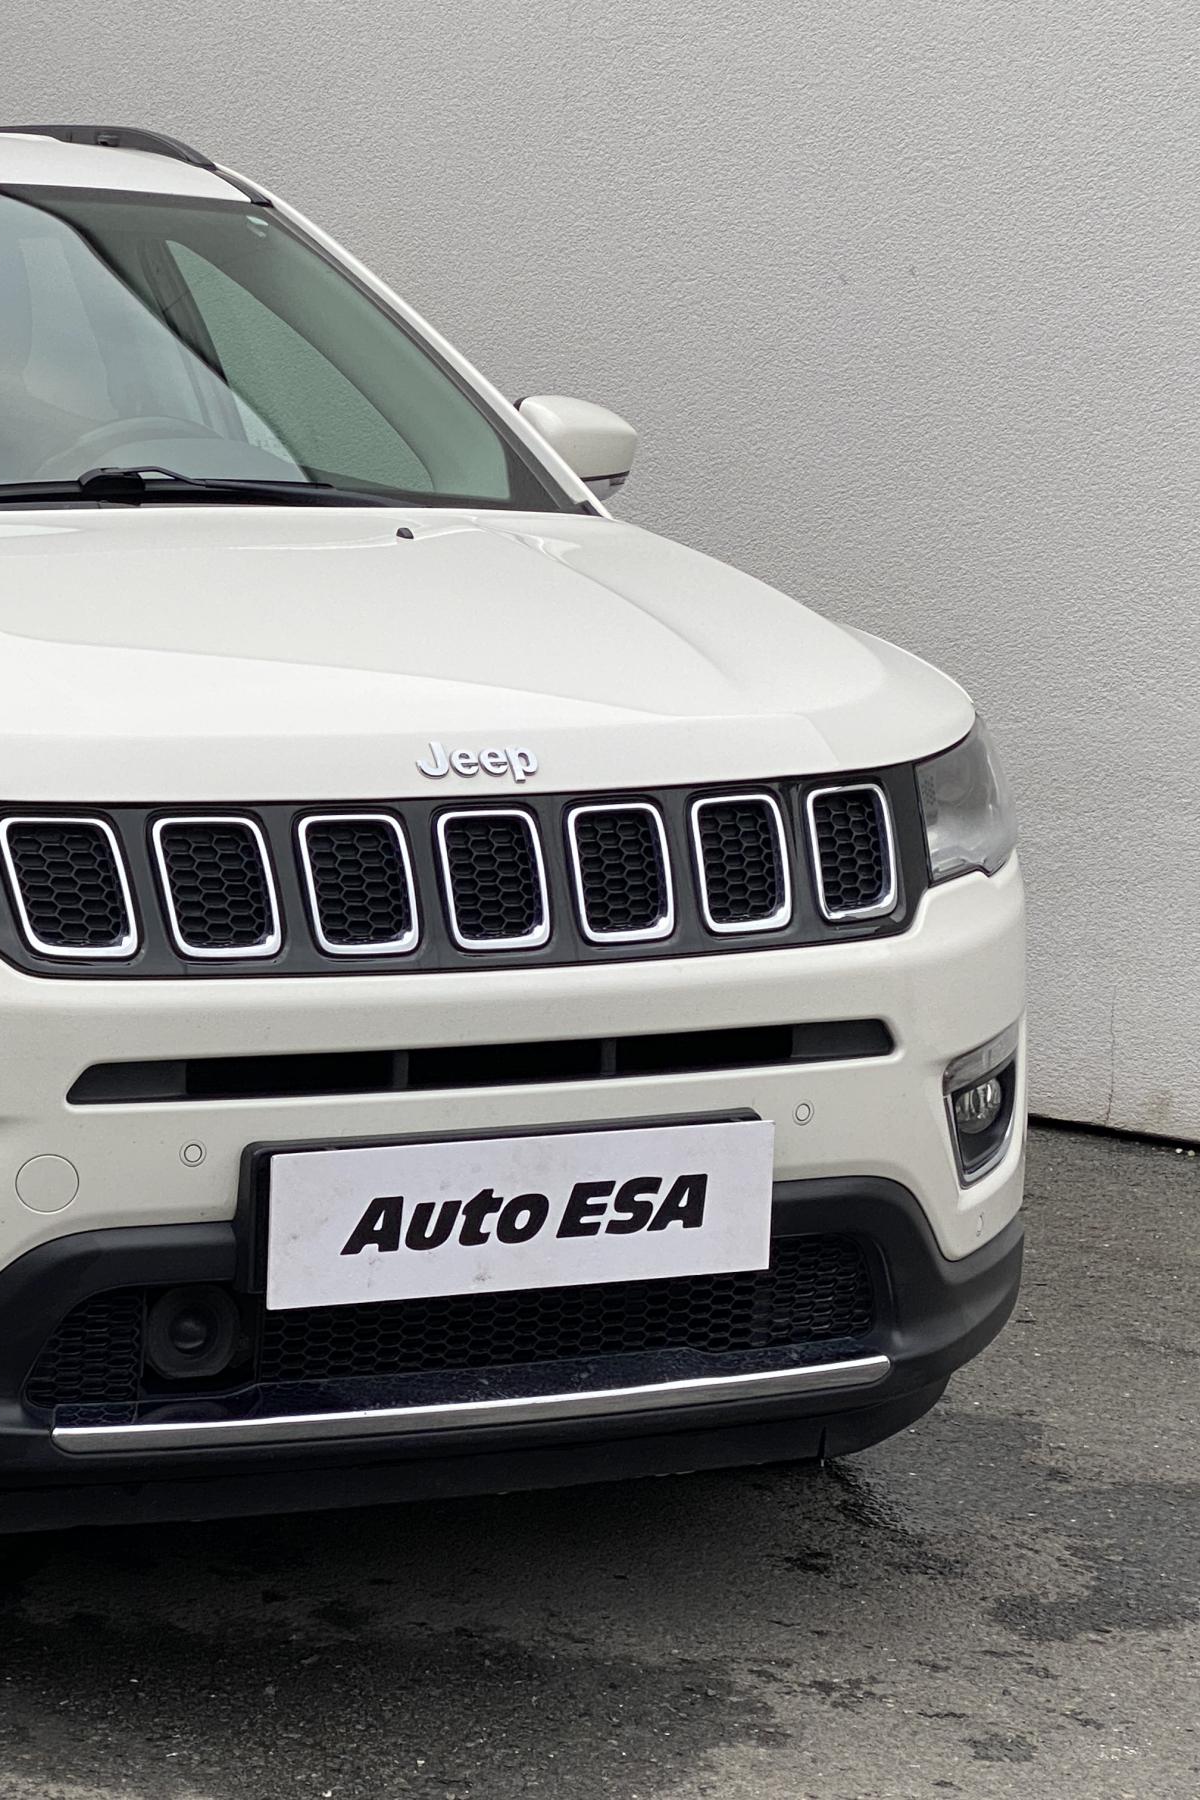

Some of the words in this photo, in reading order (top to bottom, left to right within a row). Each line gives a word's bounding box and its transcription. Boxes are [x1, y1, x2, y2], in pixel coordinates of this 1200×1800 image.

[416, 741, 538, 783] Jeep
[341, 1189, 549, 1256] Auto
[556, 1174, 707, 1238] ESA
